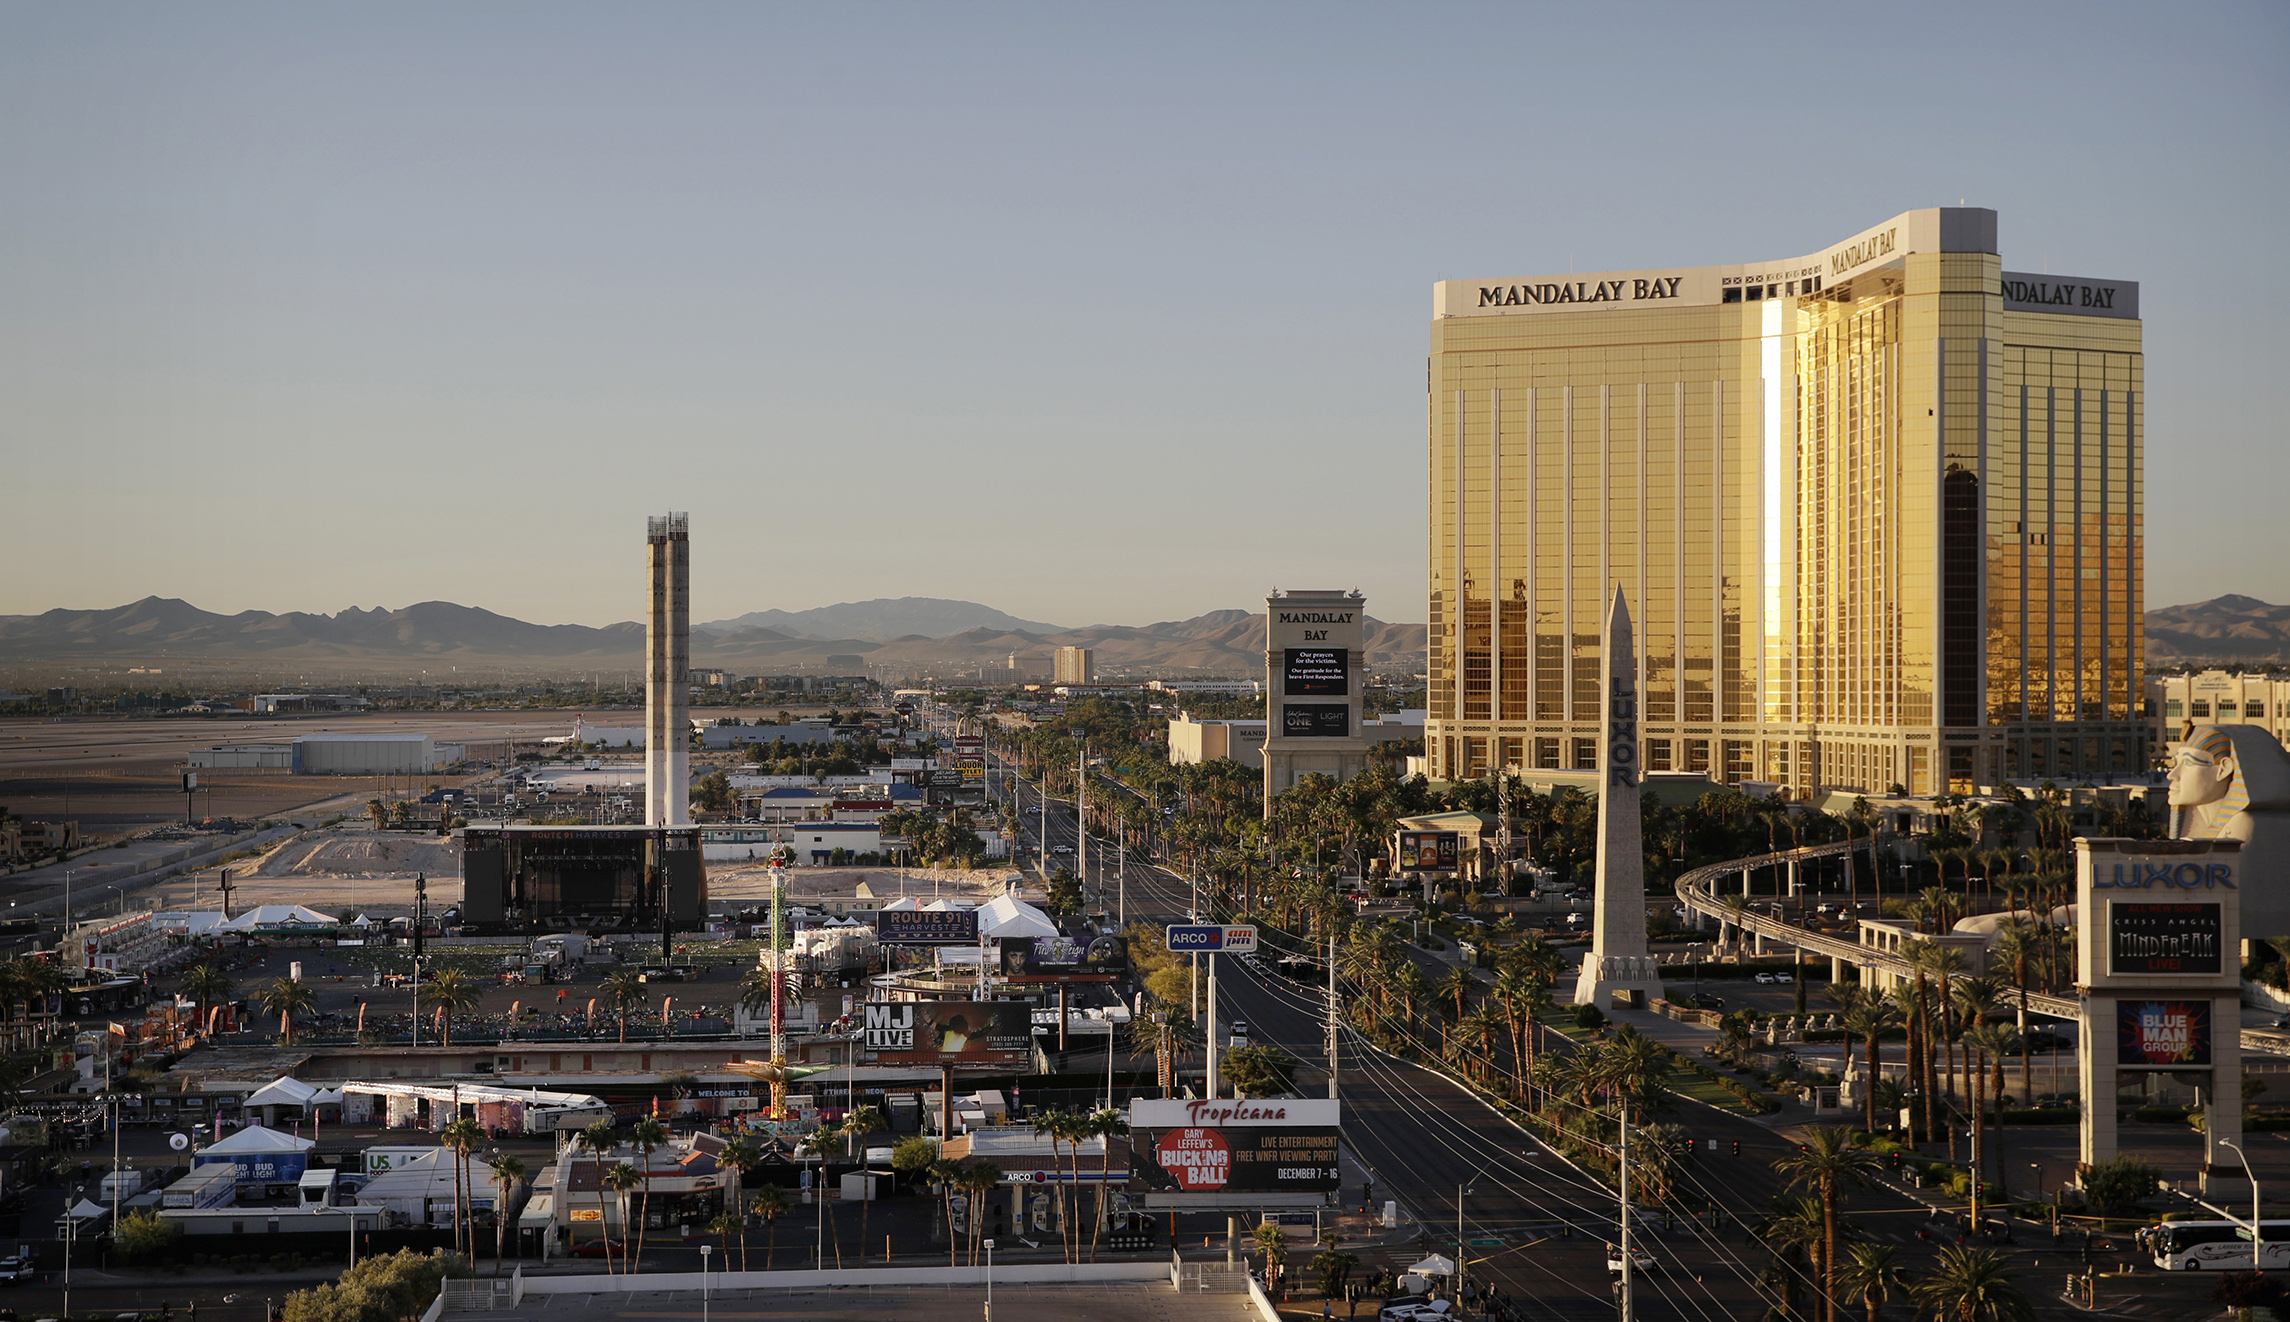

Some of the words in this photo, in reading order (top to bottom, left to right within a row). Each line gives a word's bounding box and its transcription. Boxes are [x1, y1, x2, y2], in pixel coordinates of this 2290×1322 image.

[1831, 235, 1879, 277] MANDALAY
[1879, 226, 1897, 256] BAY
[1478, 280, 1627, 307] MANDALAY
[1632, 277, 1683, 300] BAY
[2081, 286, 2116, 308] BAY
[1279, 612, 1353, 624] MANDALAY
[1304, 630, 1328, 641] BAY
[1286, 717, 1312, 726] ONE
[1320, 712, 1344, 720] LIGHT
[1611, 677, 1636, 788] LUXOR
[531, 831, 561, 839] ROUTE
[563, 831, 573, 839] 91
[575, 831, 628, 839] HARVEST
[2091, 863, 2238, 889] LUXOR
[2128, 904, 2146, 912] ALL
[2149, 904, 2172, 912] NEW
[2174, 904, 2203, 912] SHOW
[890, 912, 940, 923] ROUTE
[945, 912, 961, 923] 91
[2168, 918, 2216, 926] ANGEL
[1171, 933, 1207, 943] ARCO
[2119, 932, 2214, 957] MINDFREAK
[2149, 958, 2182, 970] LIVE!
[865, 1005, 913, 1029] MJ
[2143, 1014, 2187, 1028] BLUE
[868, 1030, 912, 1046] LIVE
[2143, 1028, 2187, 1042] MAN
[2142, 1042, 2188, 1053] GROUP
[615, 1106, 641, 1115] ROUTE
[1186, 1100, 1286, 1126] Tropicana
[1184, 1129, 1204, 1139] GARY
[1177, 1139, 1213, 1149] LEFFEW'S
[1261, 1137, 1277, 1148] LIVE
[1279, 1137, 1338, 1148] ENTERTAINMENT
[1161, 1150, 1228, 1167] BUCKING
[1236, 1150, 1254, 1162] FREE
[1256, 1150, 1277, 1162] WNFR
[1279, 1150, 1312, 1162] VIEWING
[1313, 1150, 1338, 1162] PARTY
[254, 1163, 274, 1171] BUD
[253, 1171, 276, 1179] LIGHT
[1187, 1167, 1228, 1184] BALL
[1278, 1168, 1315, 1179] DECEMBER
[1317, 1168, 1322, 1179] 7
[1329, 1168, 1338, 1179] 16
